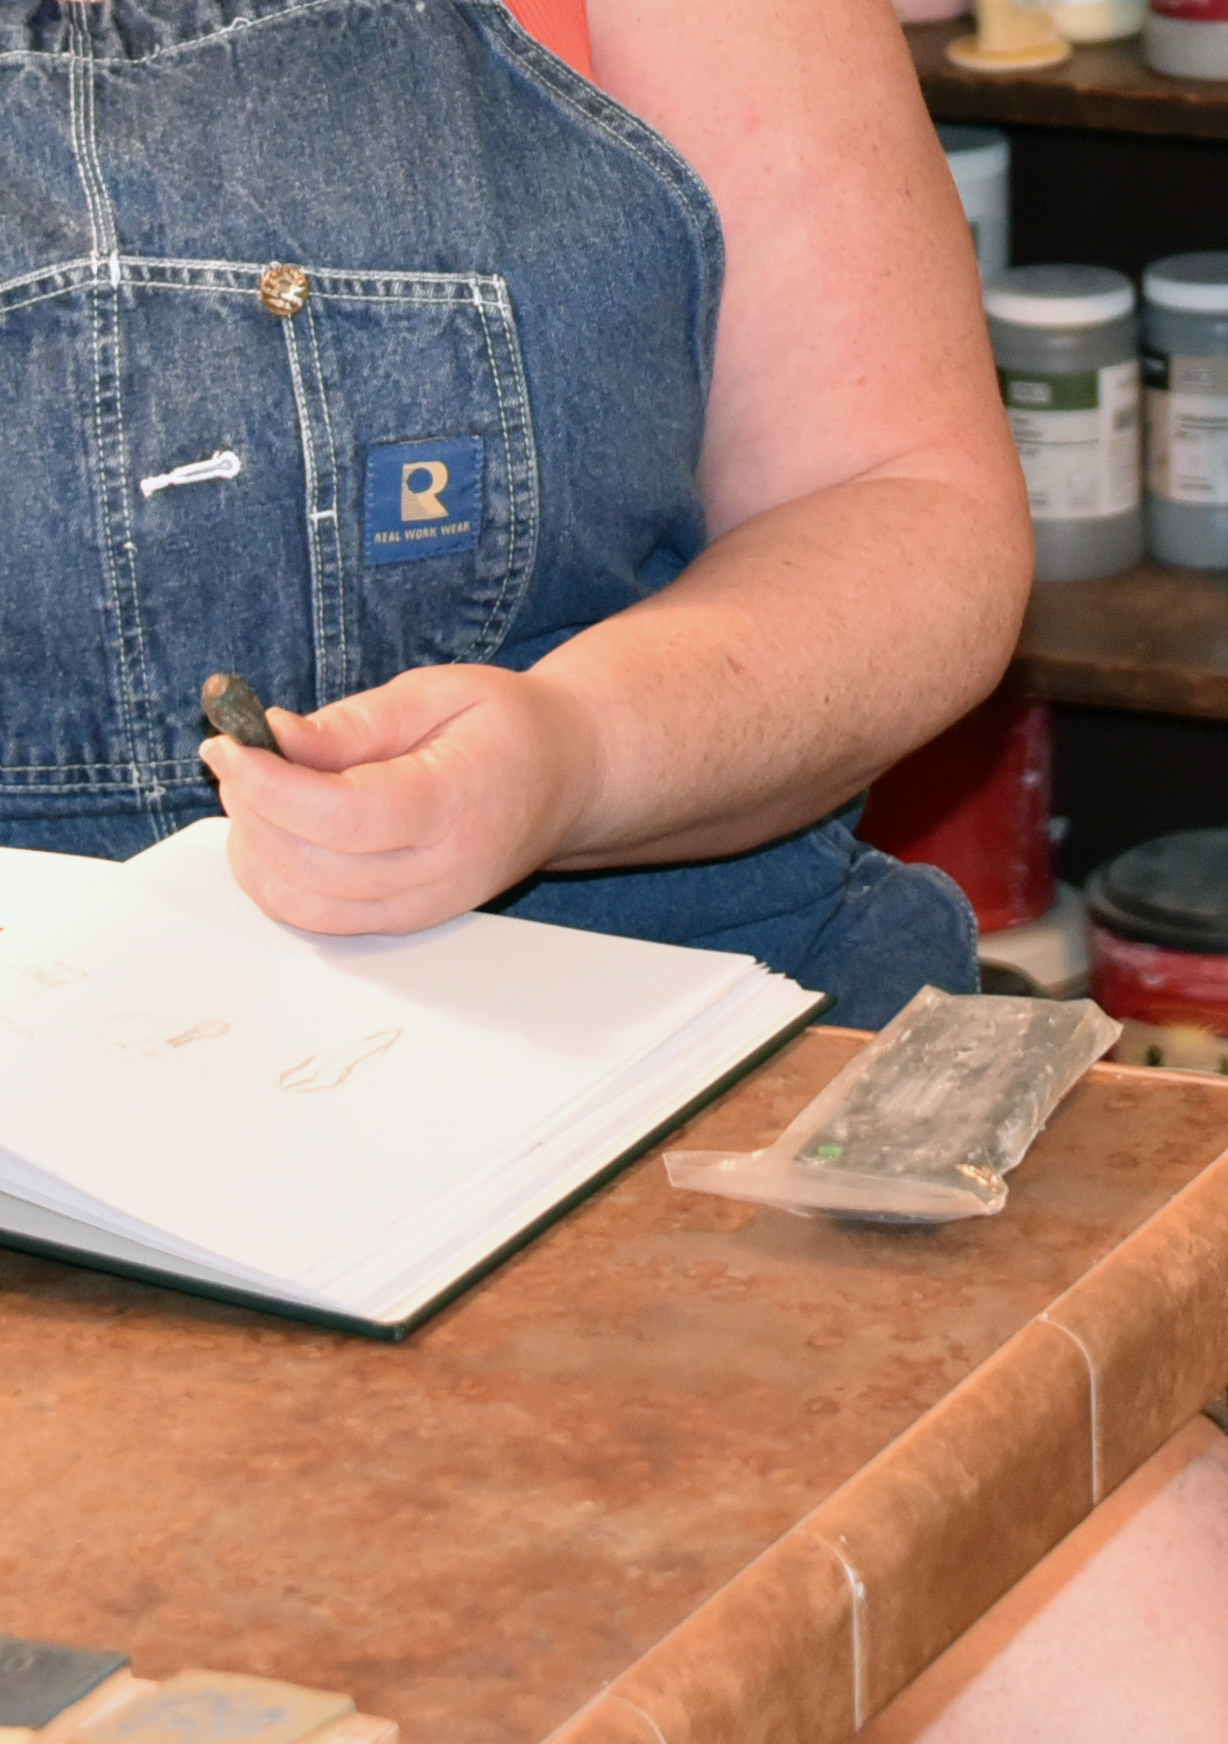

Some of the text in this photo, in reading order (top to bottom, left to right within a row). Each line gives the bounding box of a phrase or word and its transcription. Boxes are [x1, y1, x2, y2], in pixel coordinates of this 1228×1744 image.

[401, 461, 449, 521] R
[375, 520, 470, 544] REAL WORK WEAR
